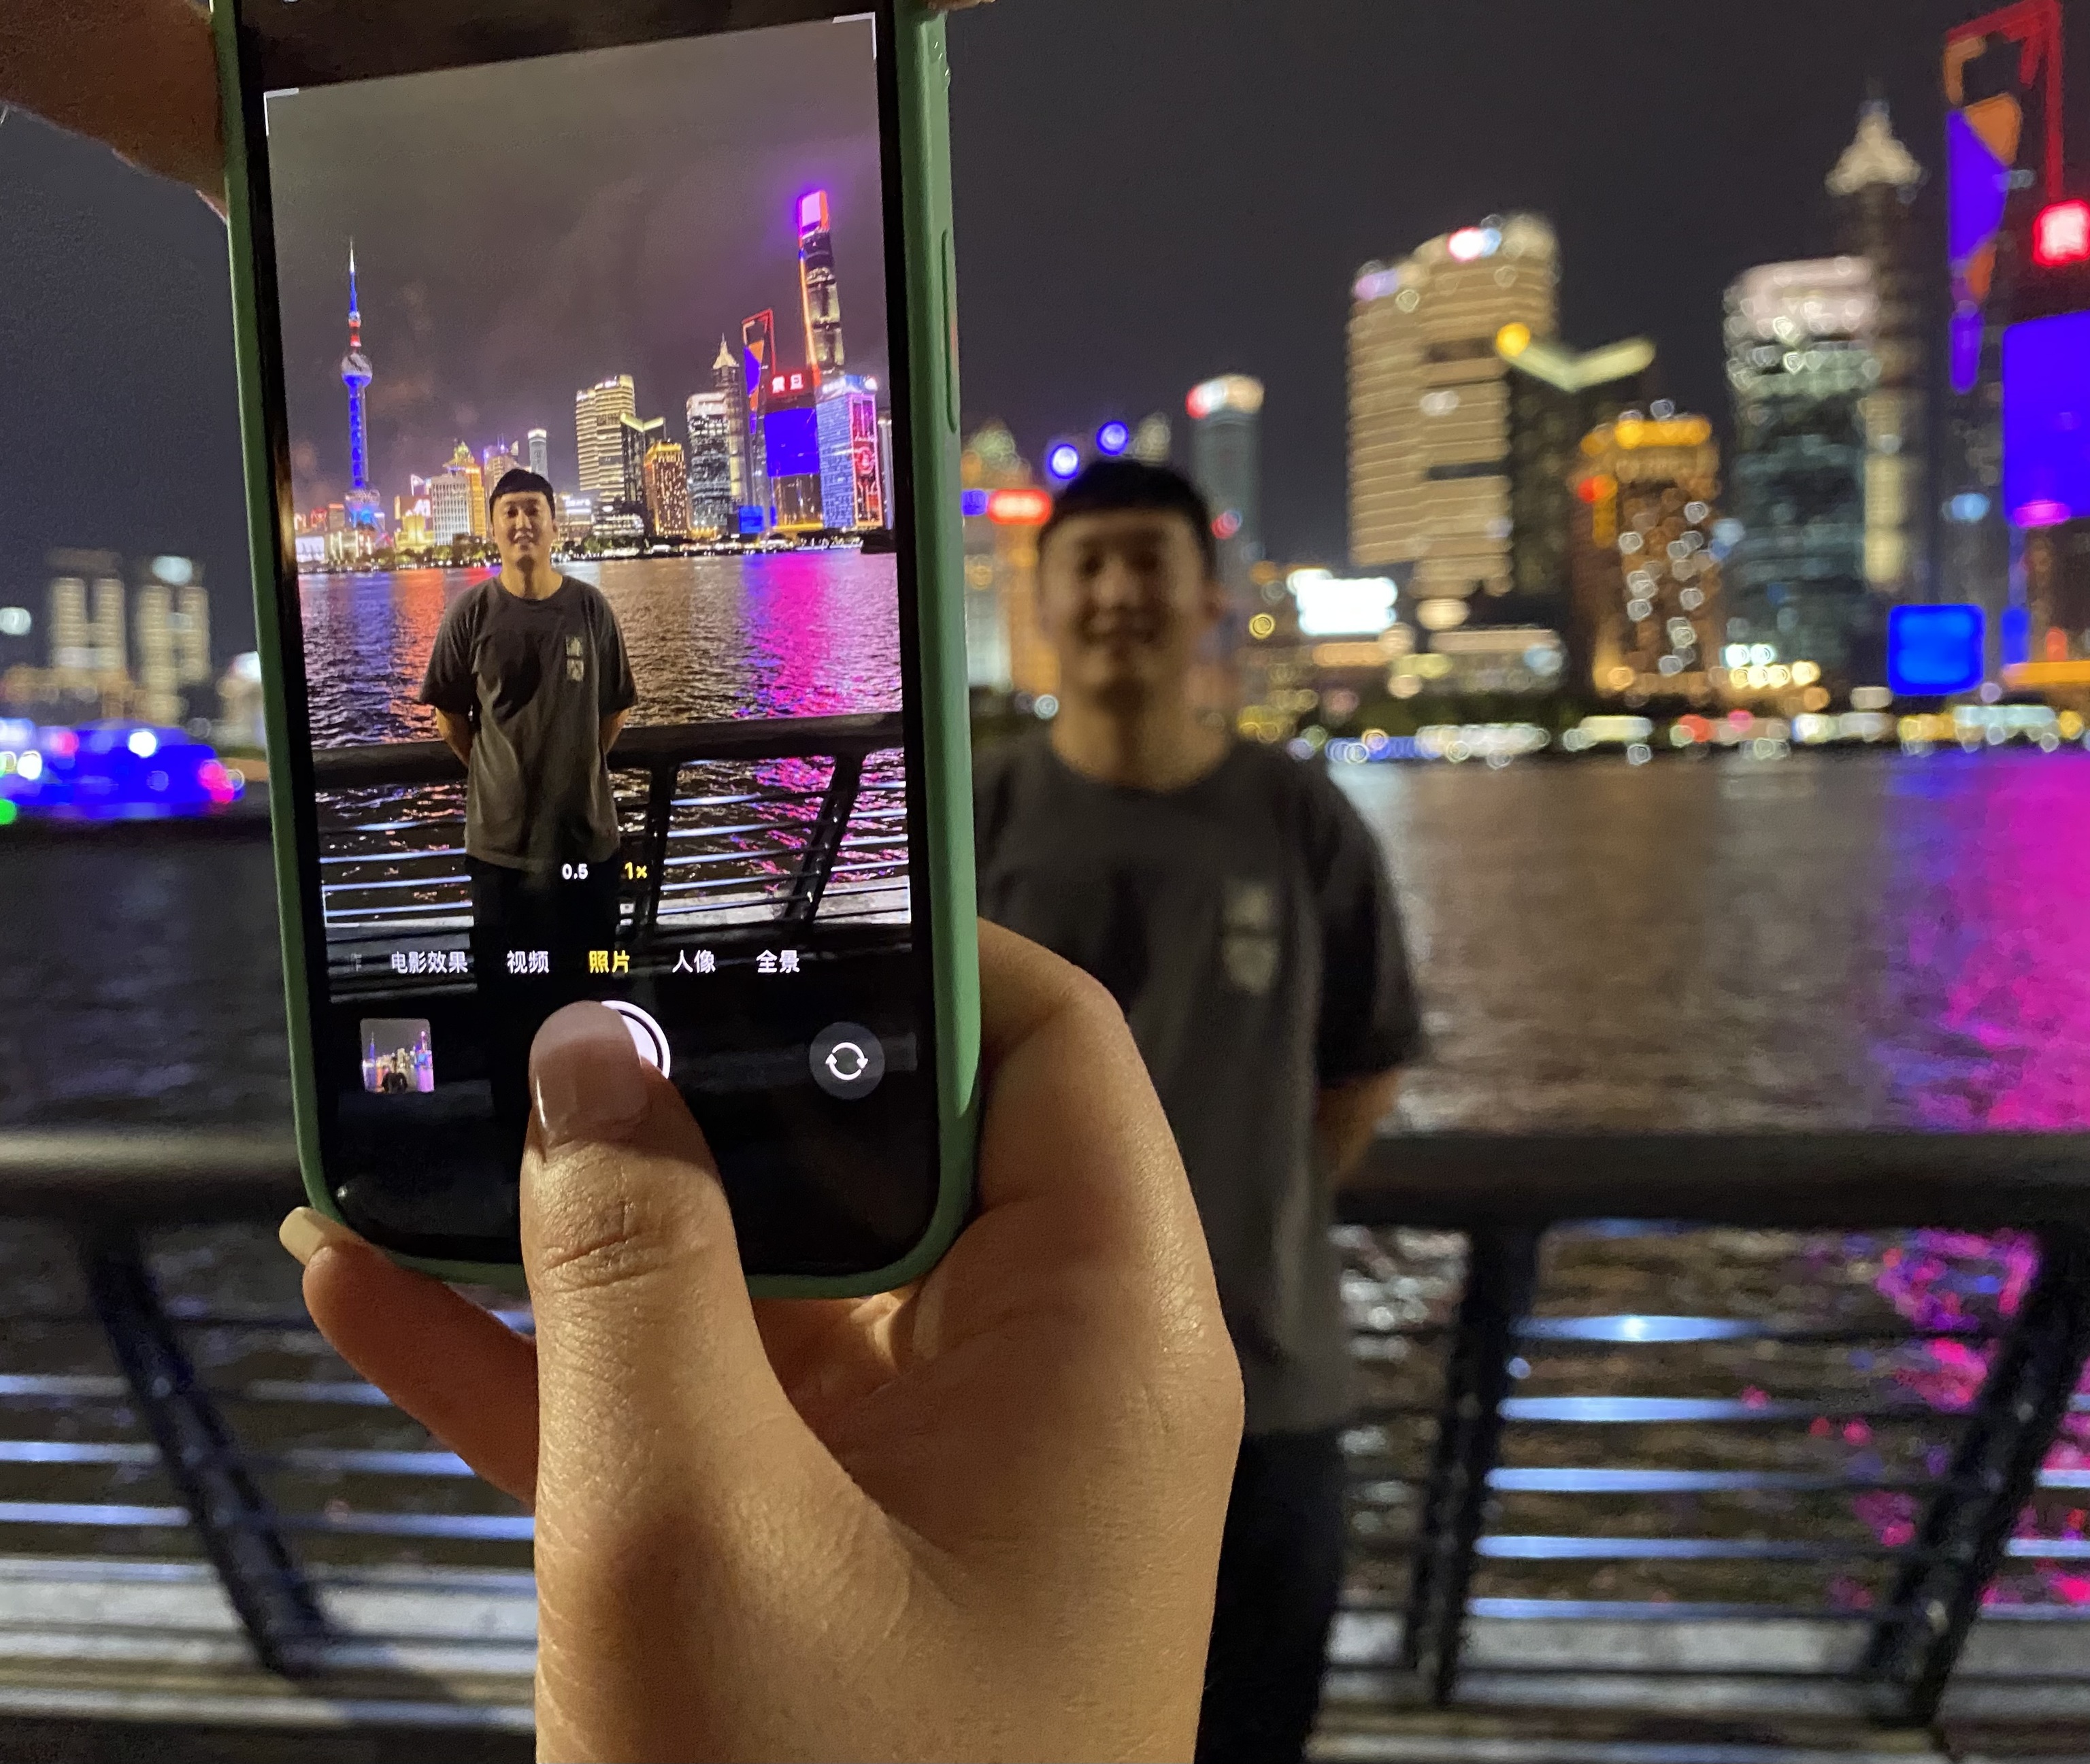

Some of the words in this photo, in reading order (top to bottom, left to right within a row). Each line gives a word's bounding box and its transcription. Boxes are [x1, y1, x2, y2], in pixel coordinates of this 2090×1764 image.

[562, 862, 588, 880] 0.5
[391, 950, 468, 974] 电影效果
[507, 950, 550, 974] 视频
[588, 950, 631, 973] 照片
[671, 949, 716, 973] 人像
[756, 949, 801, 973] 全景
